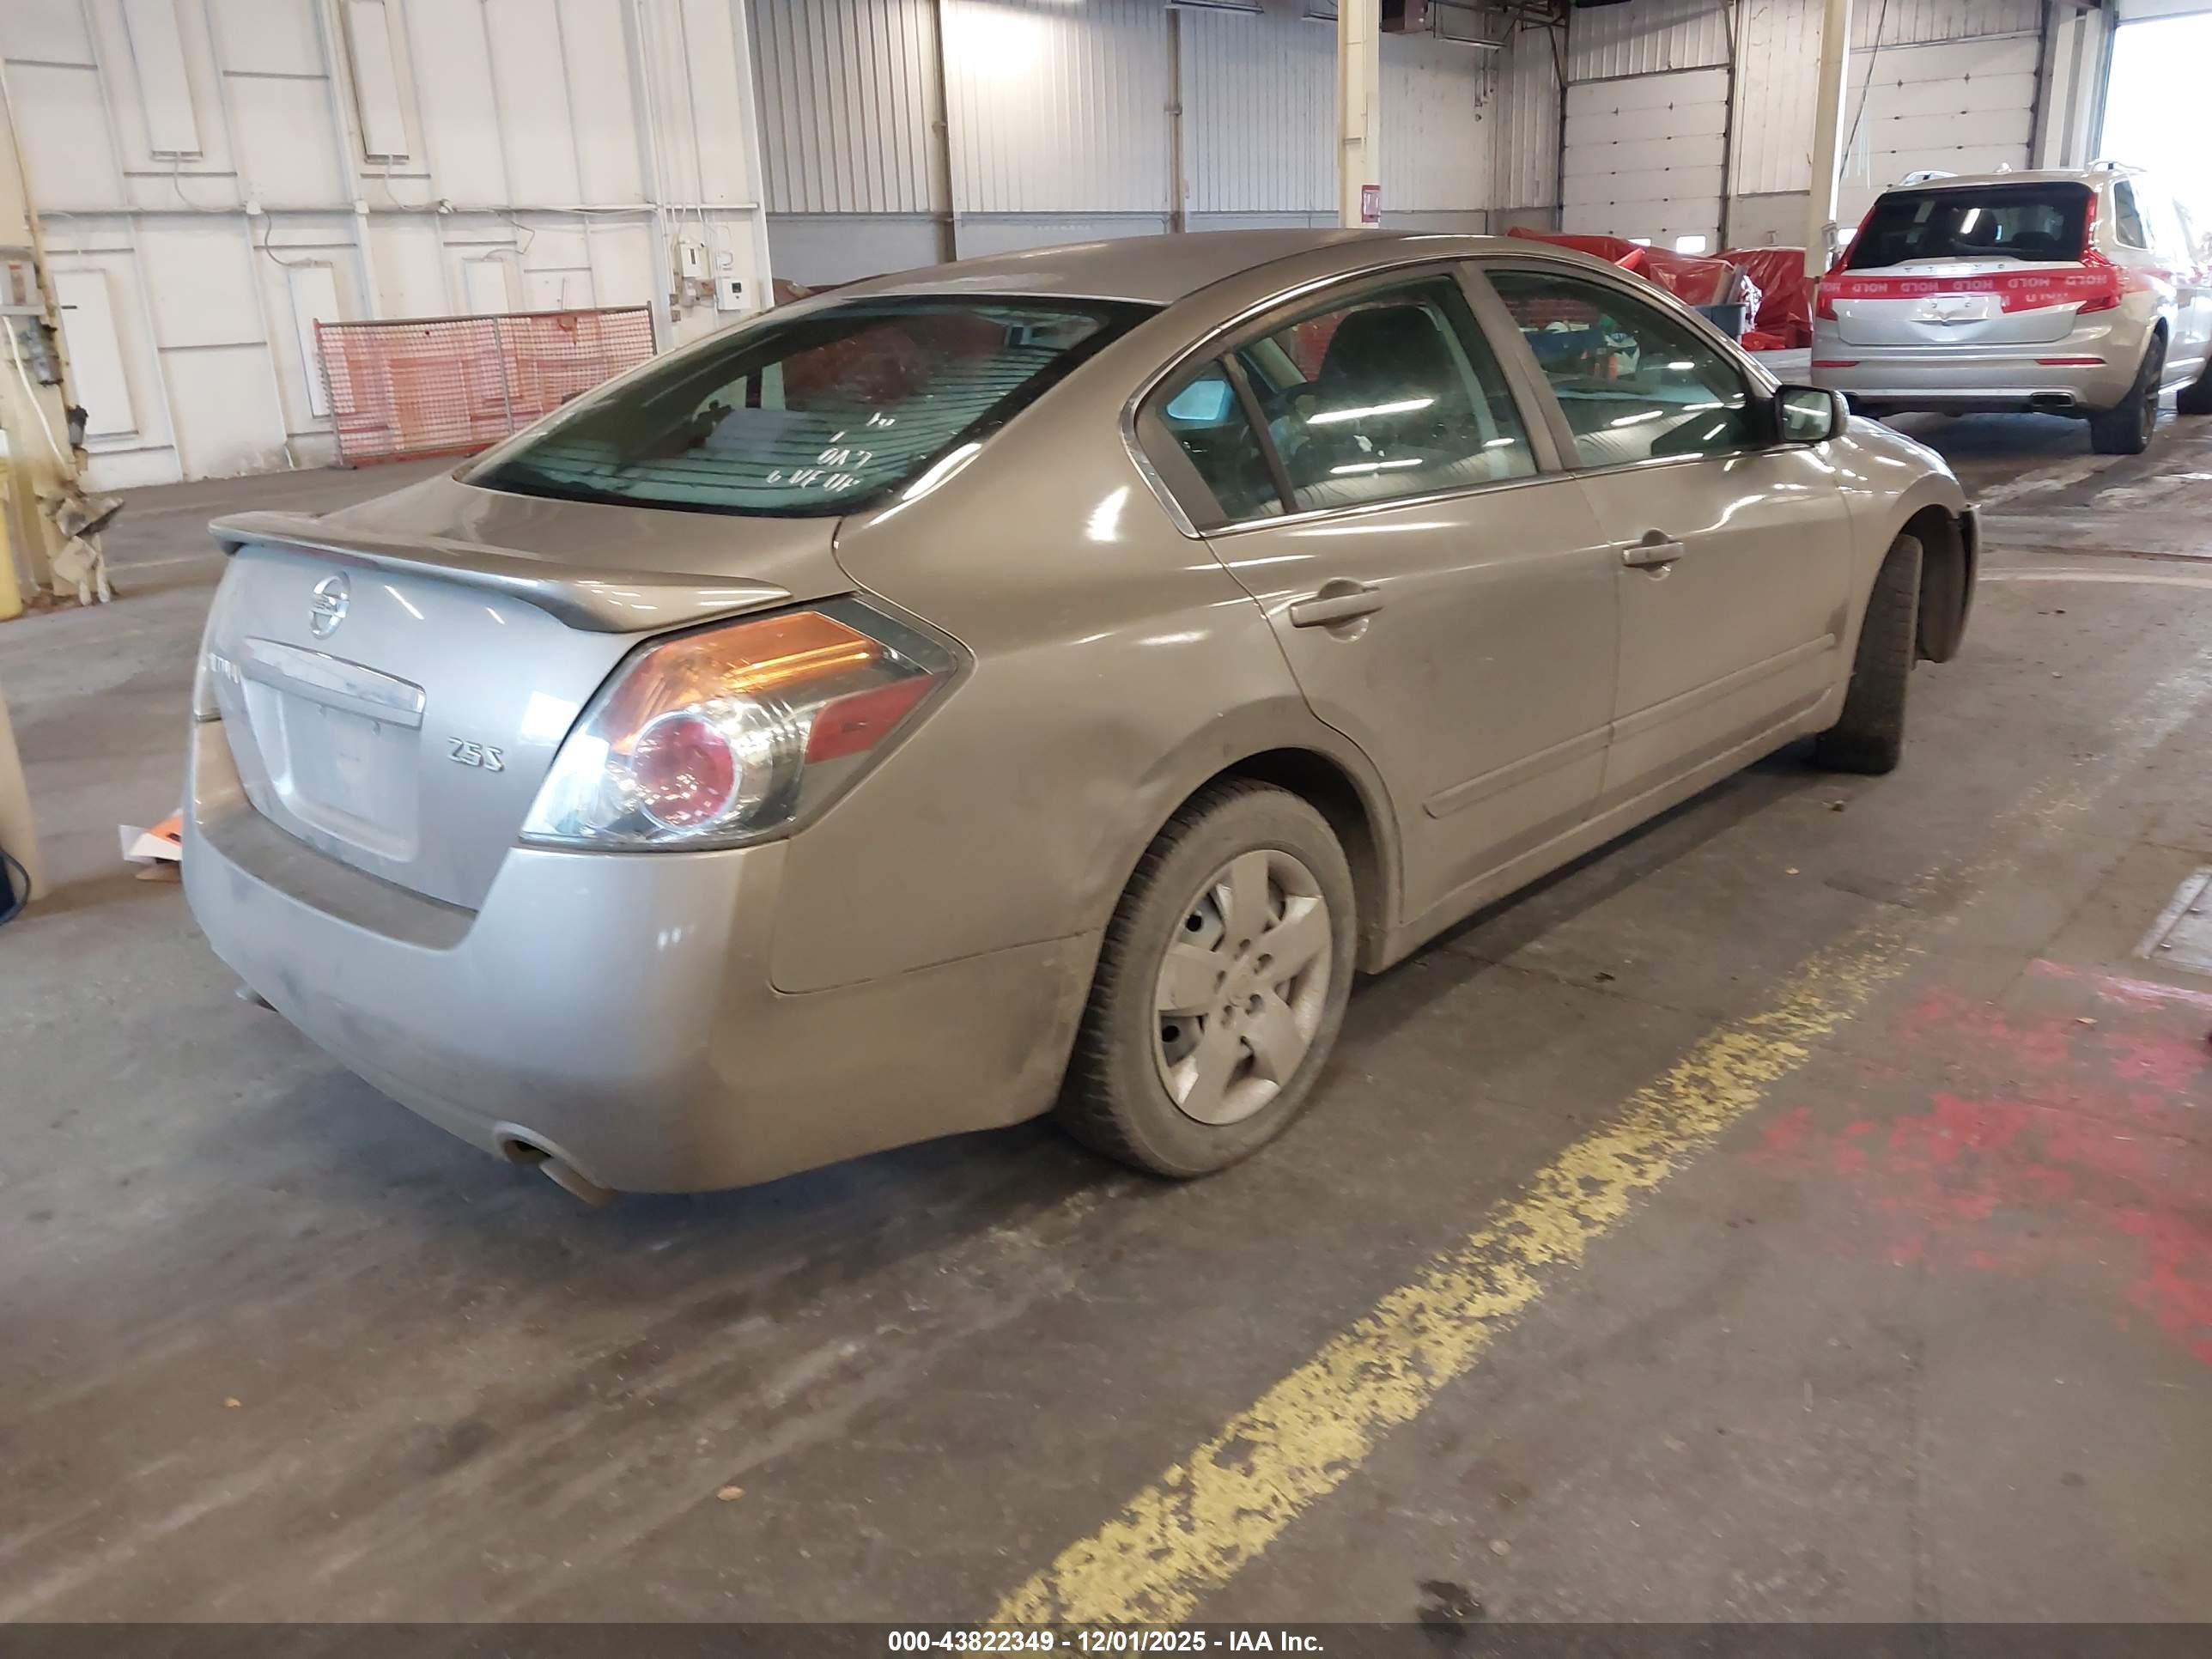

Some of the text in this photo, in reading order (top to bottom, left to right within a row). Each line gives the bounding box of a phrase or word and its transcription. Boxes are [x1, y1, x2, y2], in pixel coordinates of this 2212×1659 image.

[1899, 282, 1939, 293] HOLD
[1952, 279, 1993, 290] HOLD
[2007, 276, 2051, 289] HOLD
[1851, 283, 1888, 294] HOLD
